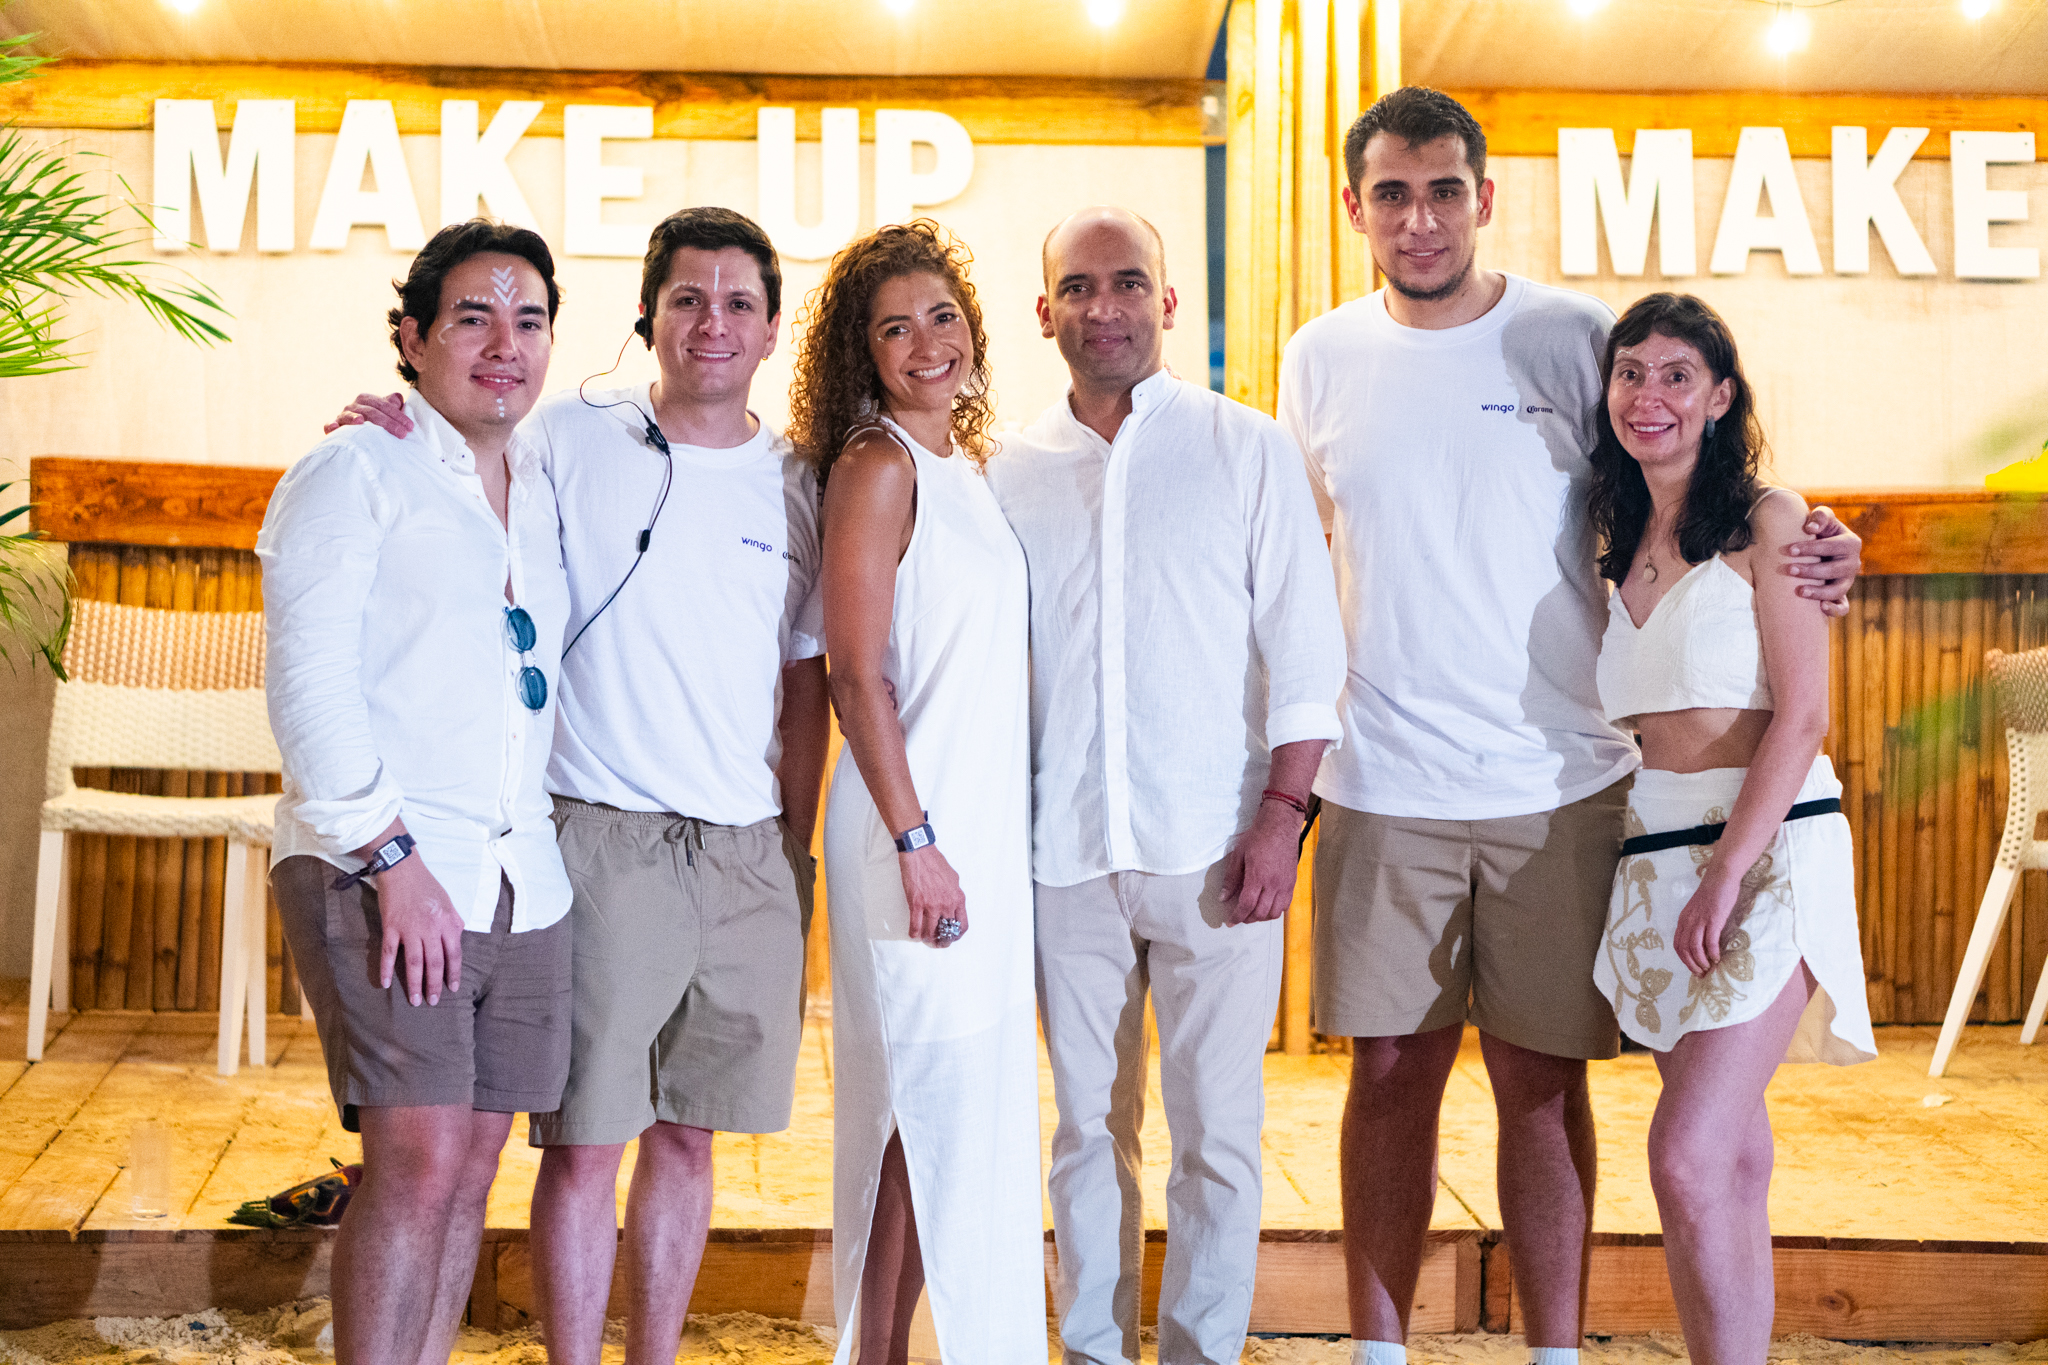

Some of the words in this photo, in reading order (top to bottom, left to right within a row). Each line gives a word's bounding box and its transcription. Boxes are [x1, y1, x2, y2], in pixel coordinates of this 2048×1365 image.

[153, 98, 653, 257] MAKE
[757, 106, 975, 259] UP
[1558, 126, 2040, 278] MAKE
[1481, 404, 1515, 414] wingo
[1526, 405, 1554, 414] Corona
[741, 536, 773, 552] wingo
